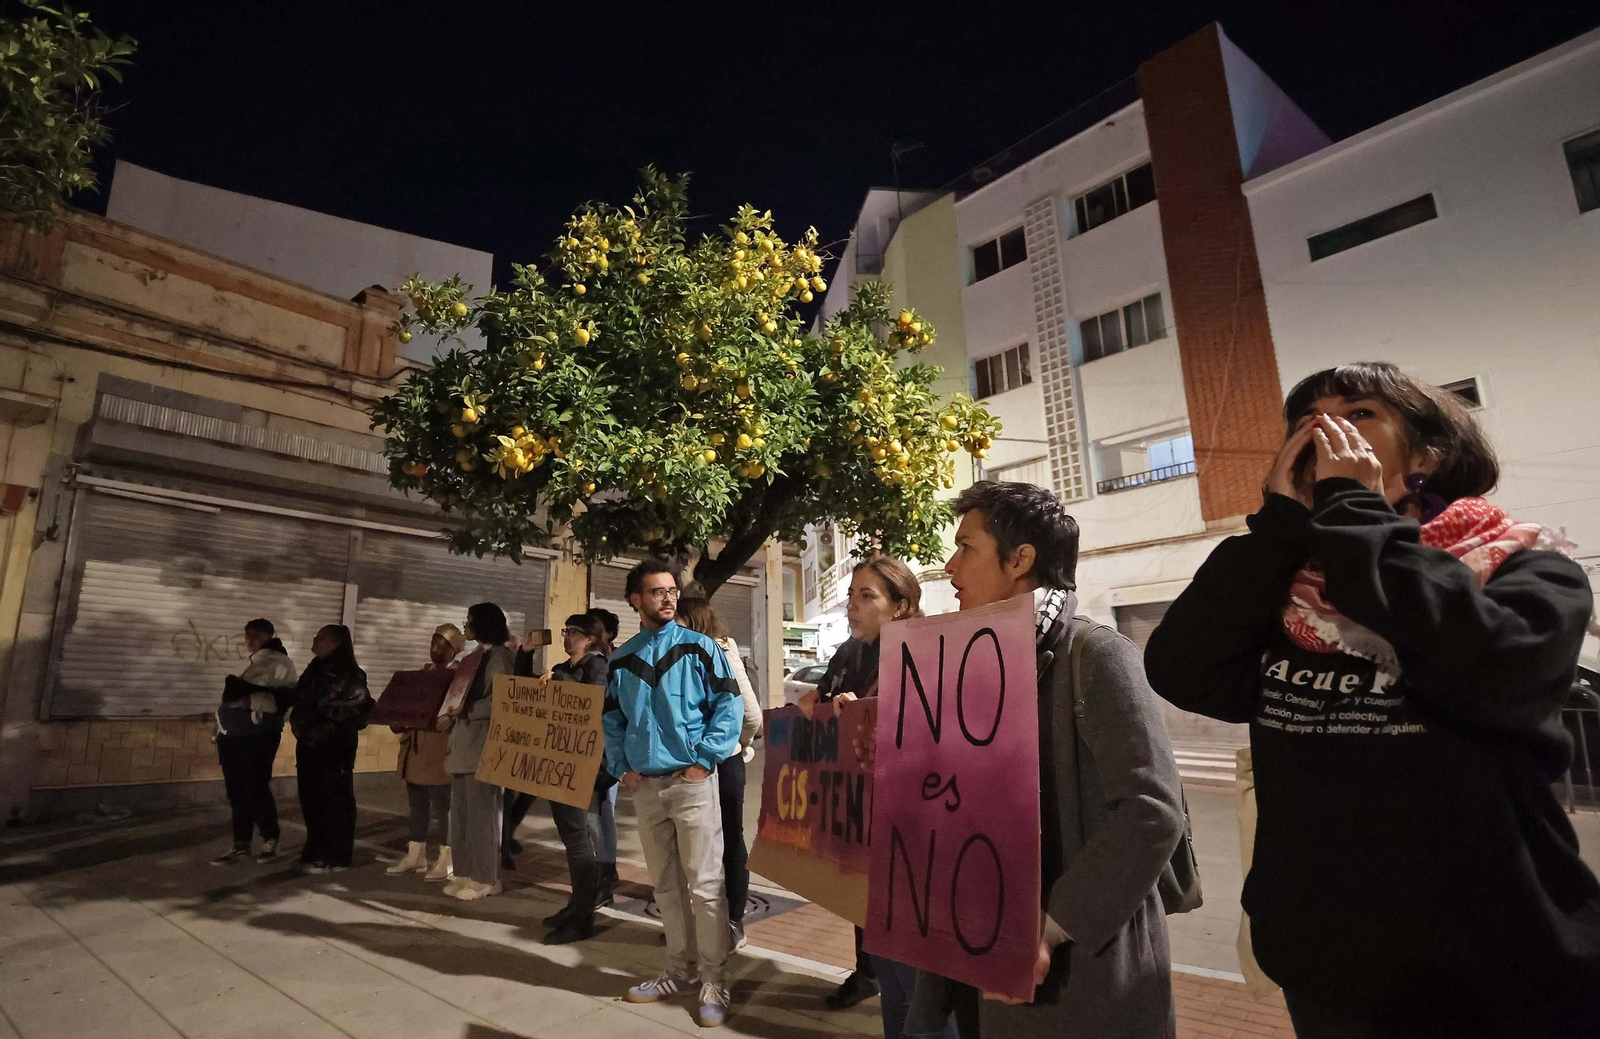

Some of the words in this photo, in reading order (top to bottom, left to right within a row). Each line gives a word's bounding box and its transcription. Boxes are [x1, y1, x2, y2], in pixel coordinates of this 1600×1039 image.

[552, 685, 592, 711] MORENO
[896, 627, 1005, 748] NO
[511, 702, 533, 716] TIENES
[536, 708, 547, 719] QUE
[552, 711, 590, 726] ENTERAR
[1264, 704, 1292, 719] Acción
[1339, 711, 1388, 722] colectiva
[488, 721, 501, 742] LA
[1316, 725, 1323, 733] o
[494, 748, 507, 772] Y
[511, 751, 576, 791] UNIVERSAL
[922, 772, 961, 812] es
[886, 825, 1004, 955] NO
